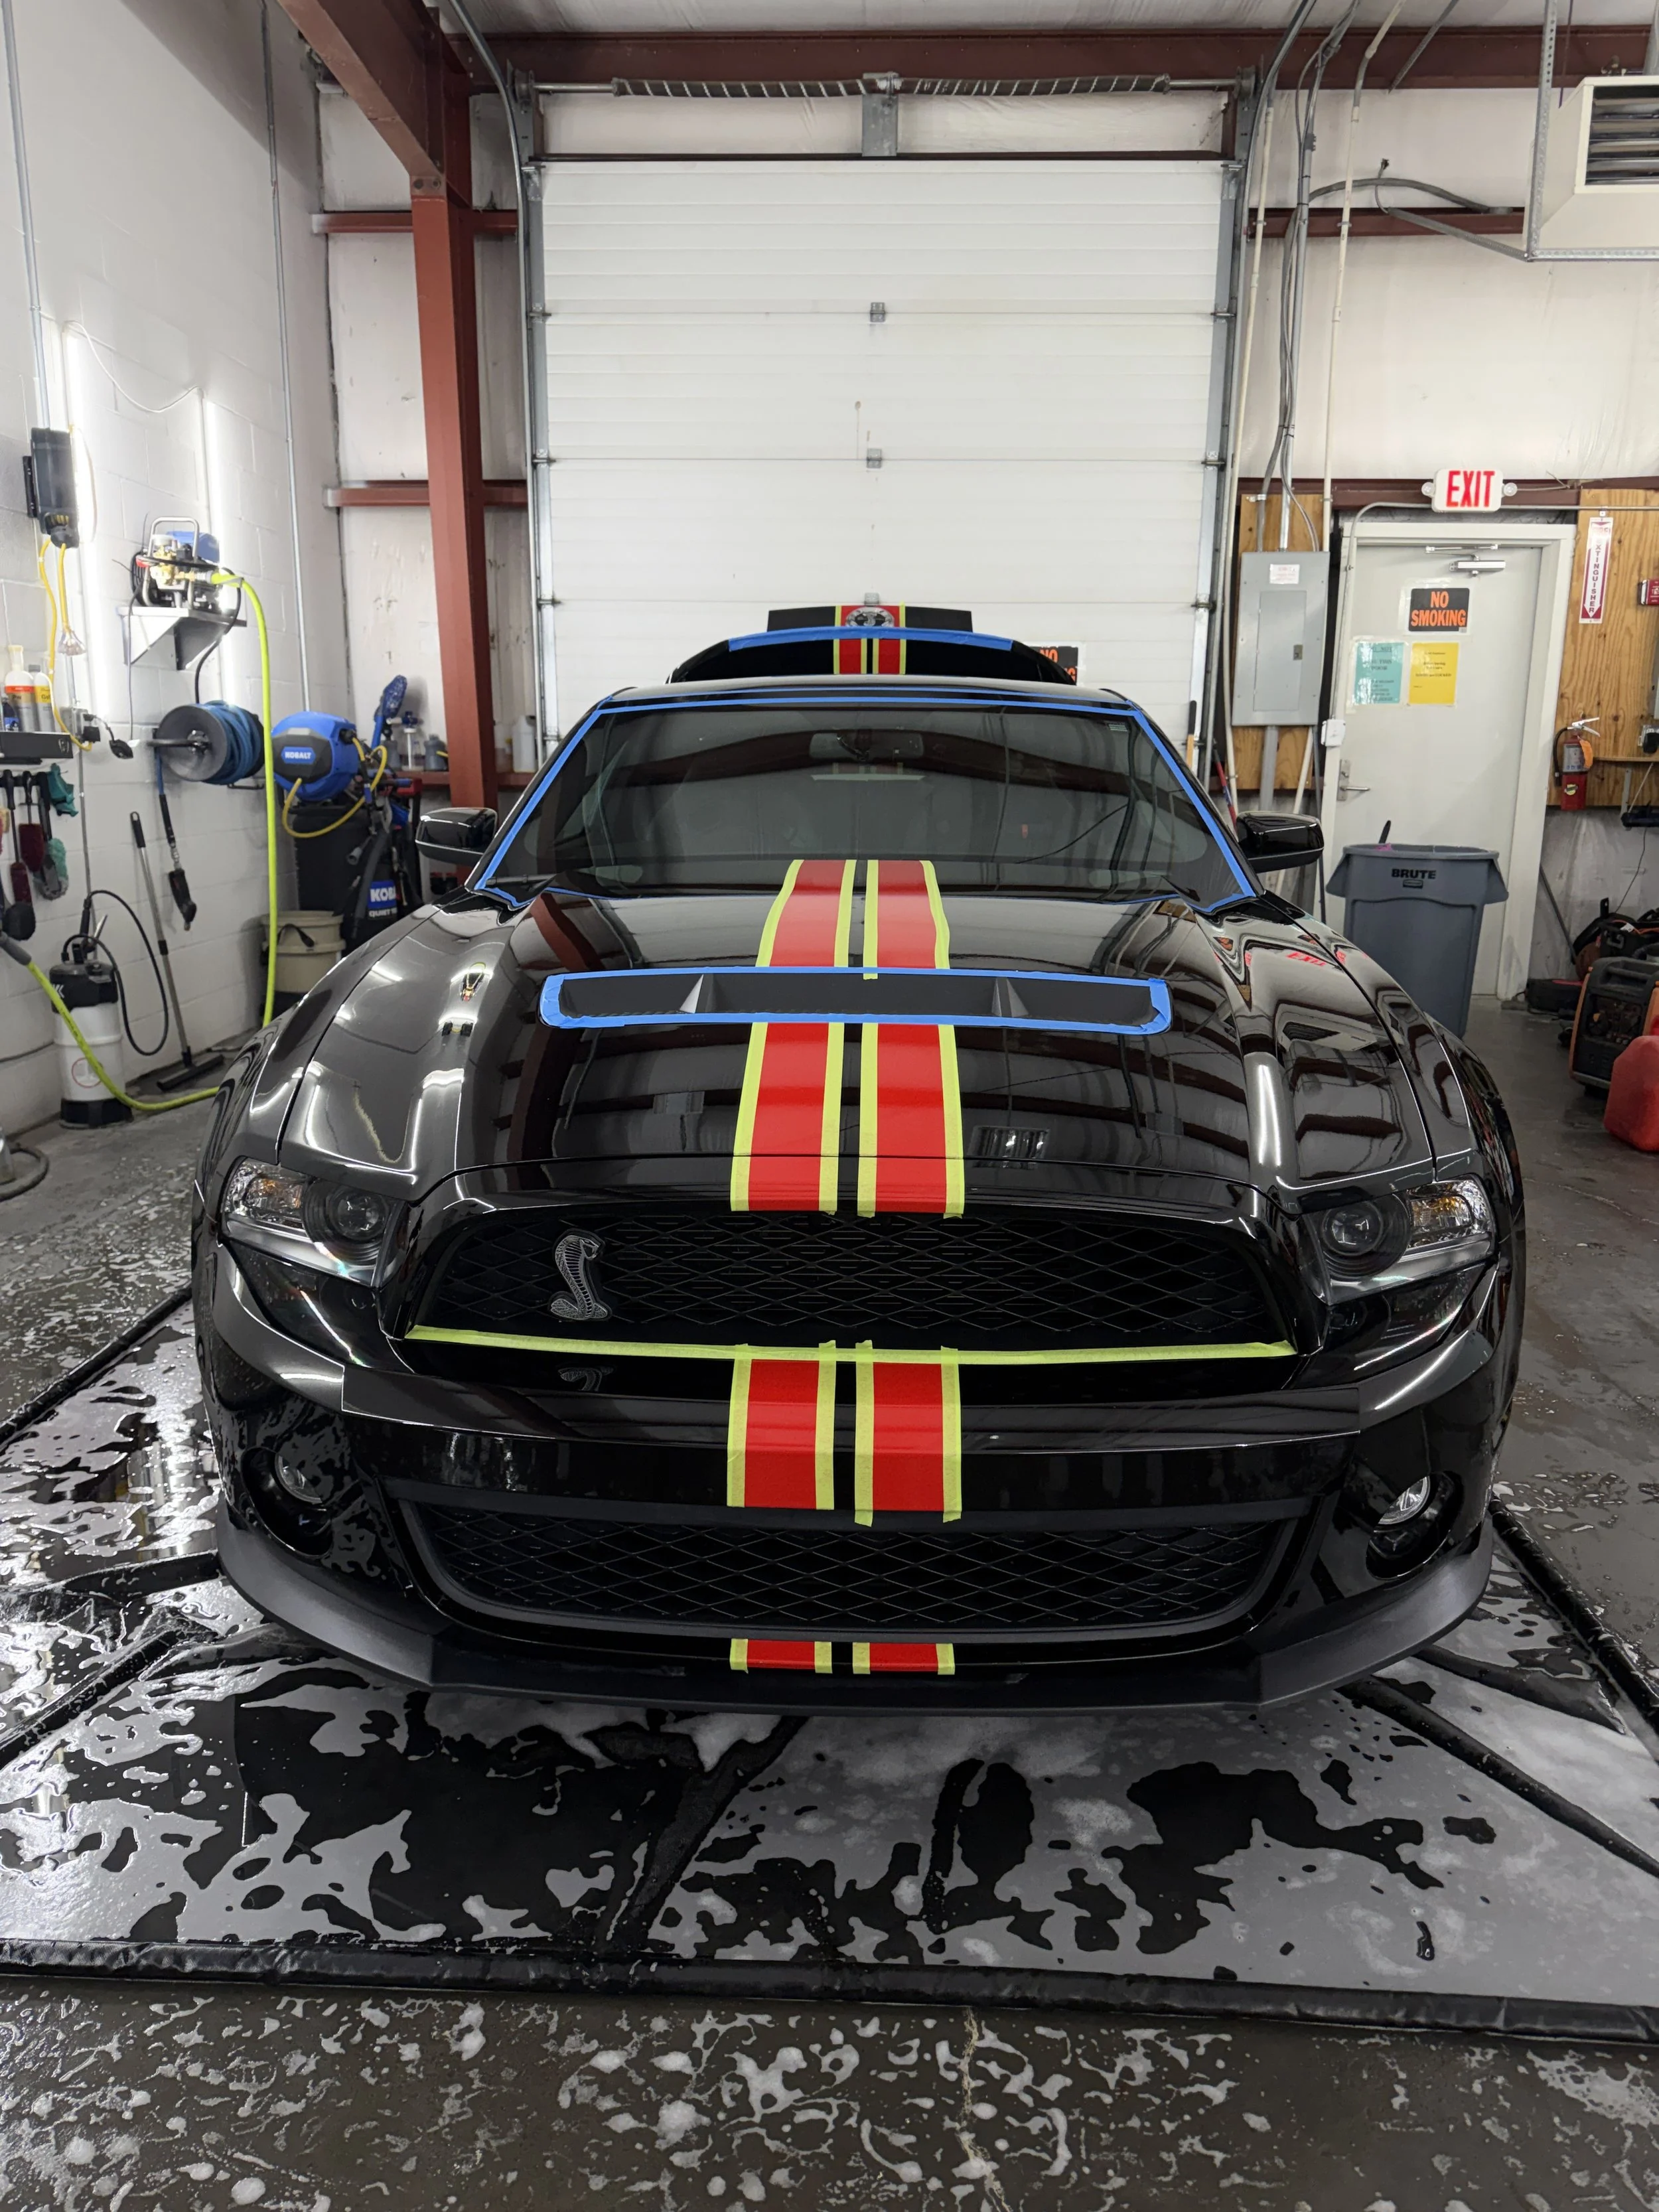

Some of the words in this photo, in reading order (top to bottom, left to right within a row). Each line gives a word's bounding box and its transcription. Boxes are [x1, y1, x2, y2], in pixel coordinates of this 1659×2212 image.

[1446, 471, 1495, 507] EXIT
[1589, 538, 1602, 613] XTINGUISHER
[1430, 591, 1449, 609] NO
[1411, 609, 1466, 627] SMOKING
[285, 751, 311, 760] KOBALT
[1391, 868, 1437, 879] BRUTE
